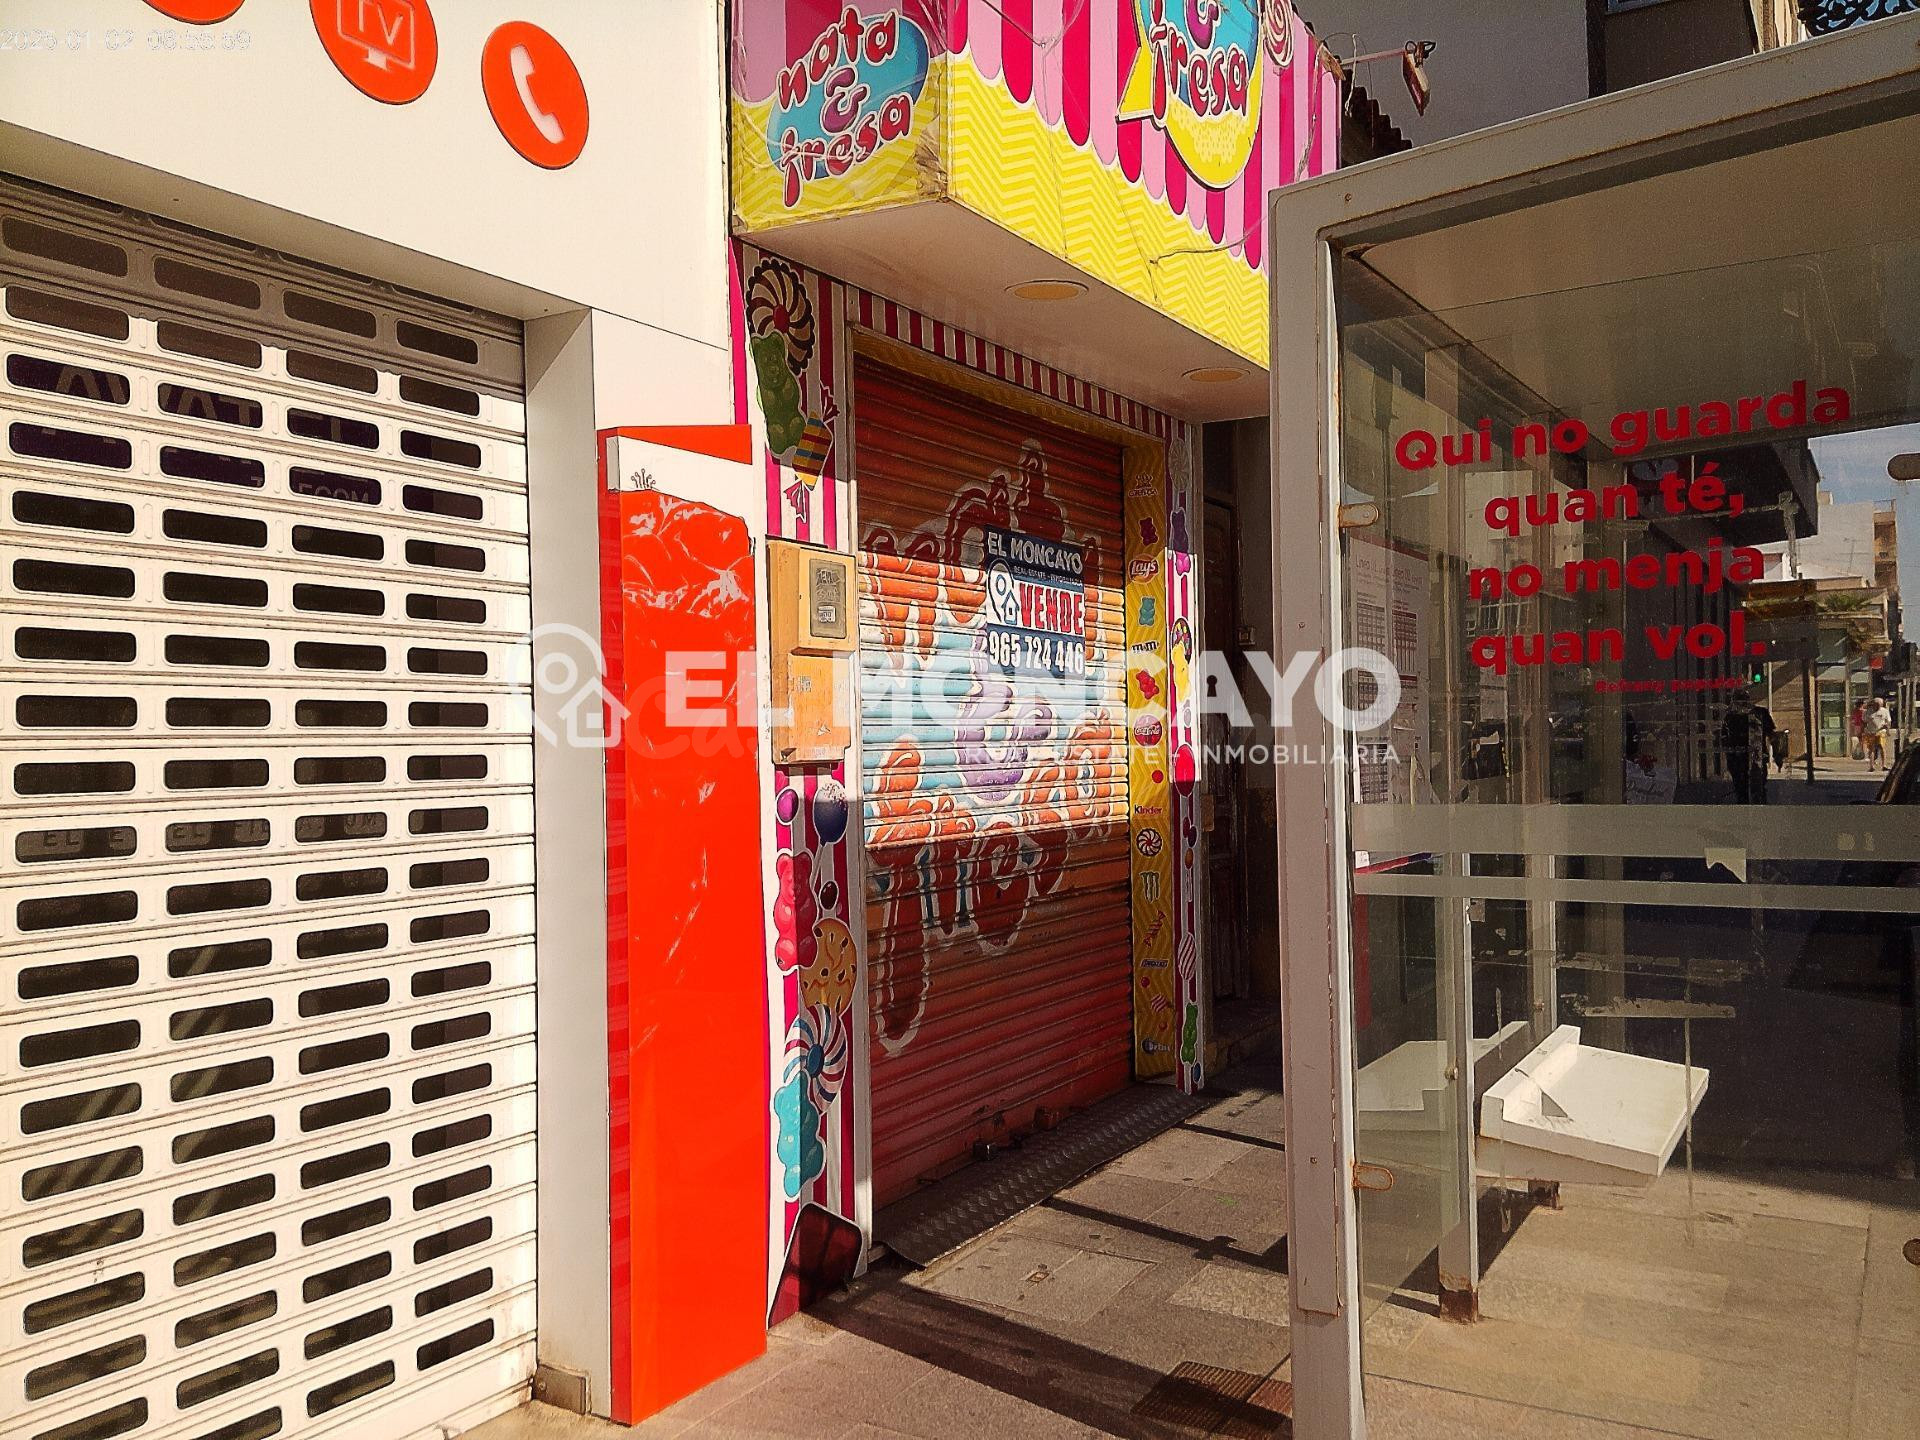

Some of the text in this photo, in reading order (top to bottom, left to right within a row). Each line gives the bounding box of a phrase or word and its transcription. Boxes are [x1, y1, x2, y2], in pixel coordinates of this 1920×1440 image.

[779, 6, 897, 111] nata
[1151, 0, 1248, 120] fresa
[782, 95, 912, 208] fresa
[1395, 380, 1851, 471] Qui no guarda
[1484, 461, 1745, 537] quan té,
[988, 531, 1083, 575] EL MONCAYO
[1468, 562, 1543, 600] no
[1564, 537, 1765, 593] menja
[1019, 582, 1083, 636] VENDE
[1470, 626, 1625, 675] quan
[1646, 610, 1767, 660] vol.
[988, 631, 1084, 674] 965 724 446
